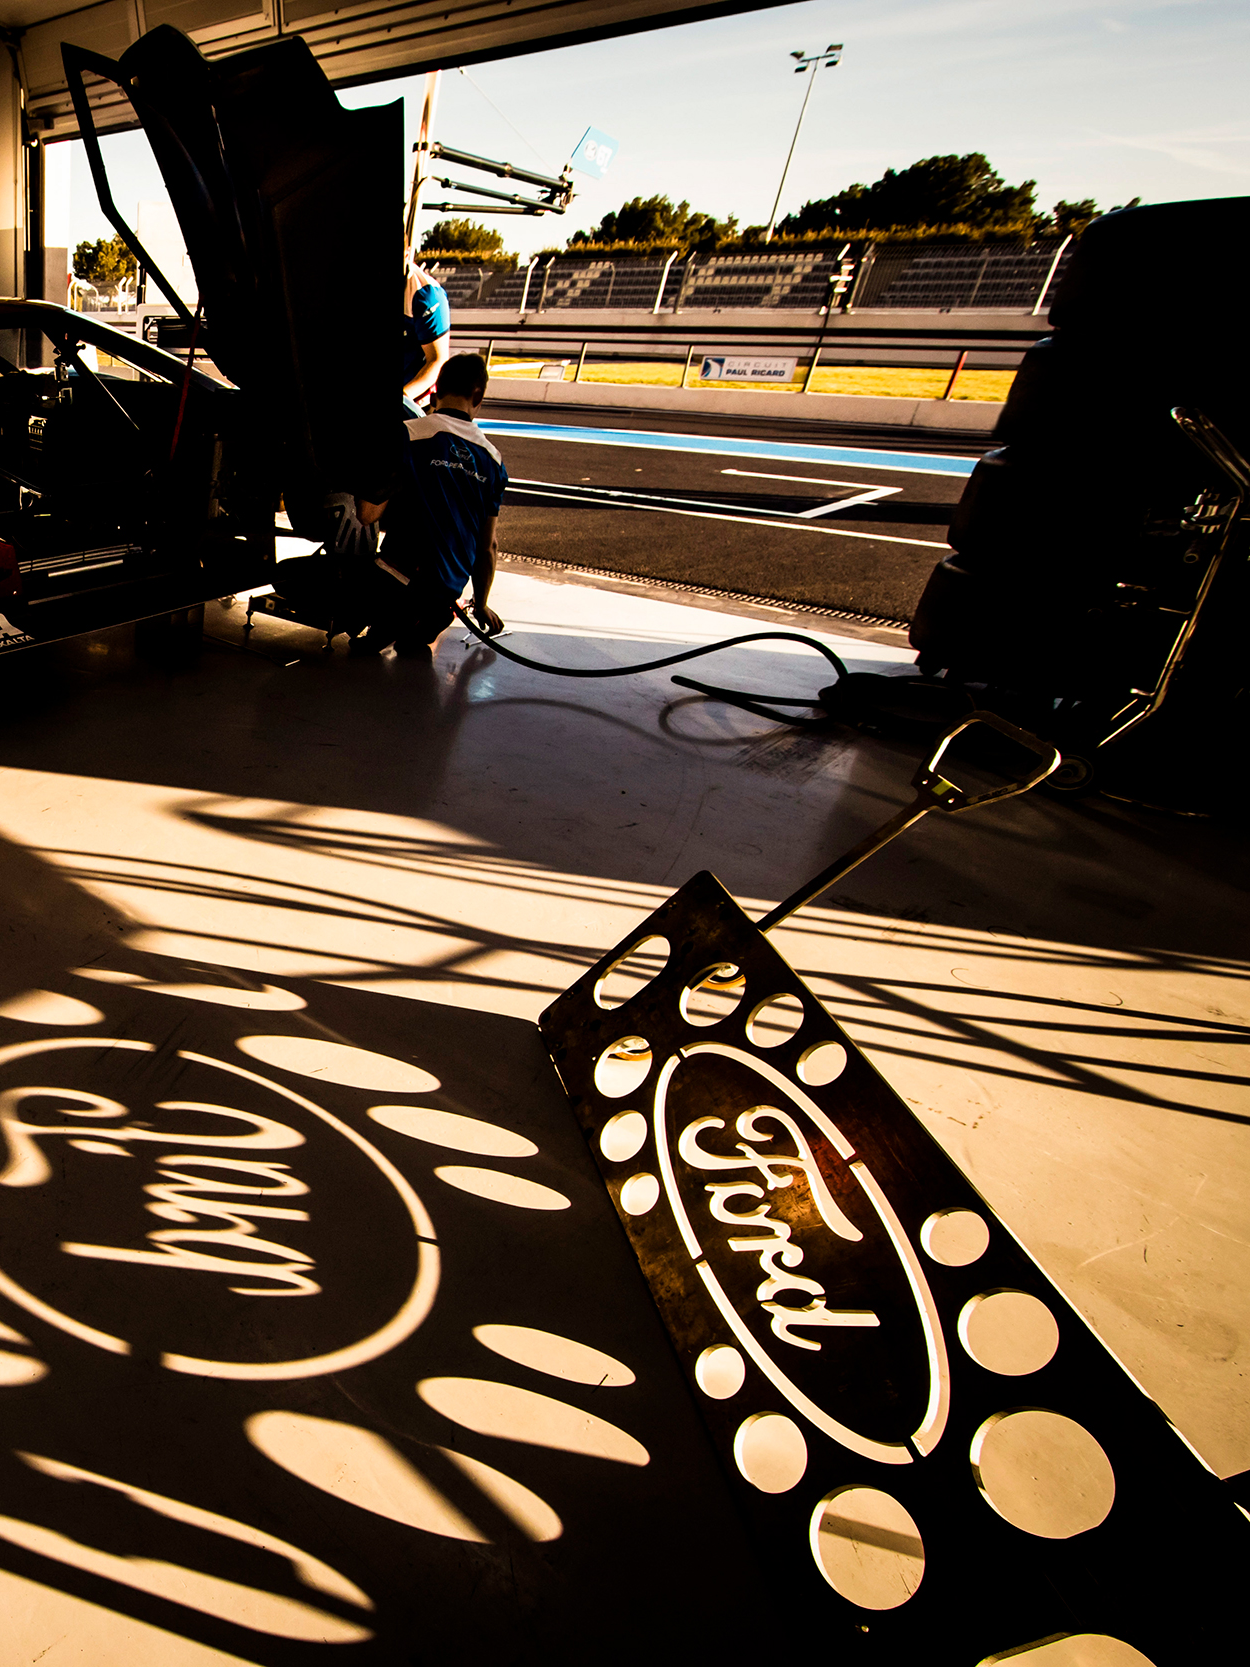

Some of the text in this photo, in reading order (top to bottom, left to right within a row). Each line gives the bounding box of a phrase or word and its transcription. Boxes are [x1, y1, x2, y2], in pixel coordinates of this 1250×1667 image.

[726, 368, 785, 377] PAUL RICARD
[677, 1104, 881, 1352] Ford
